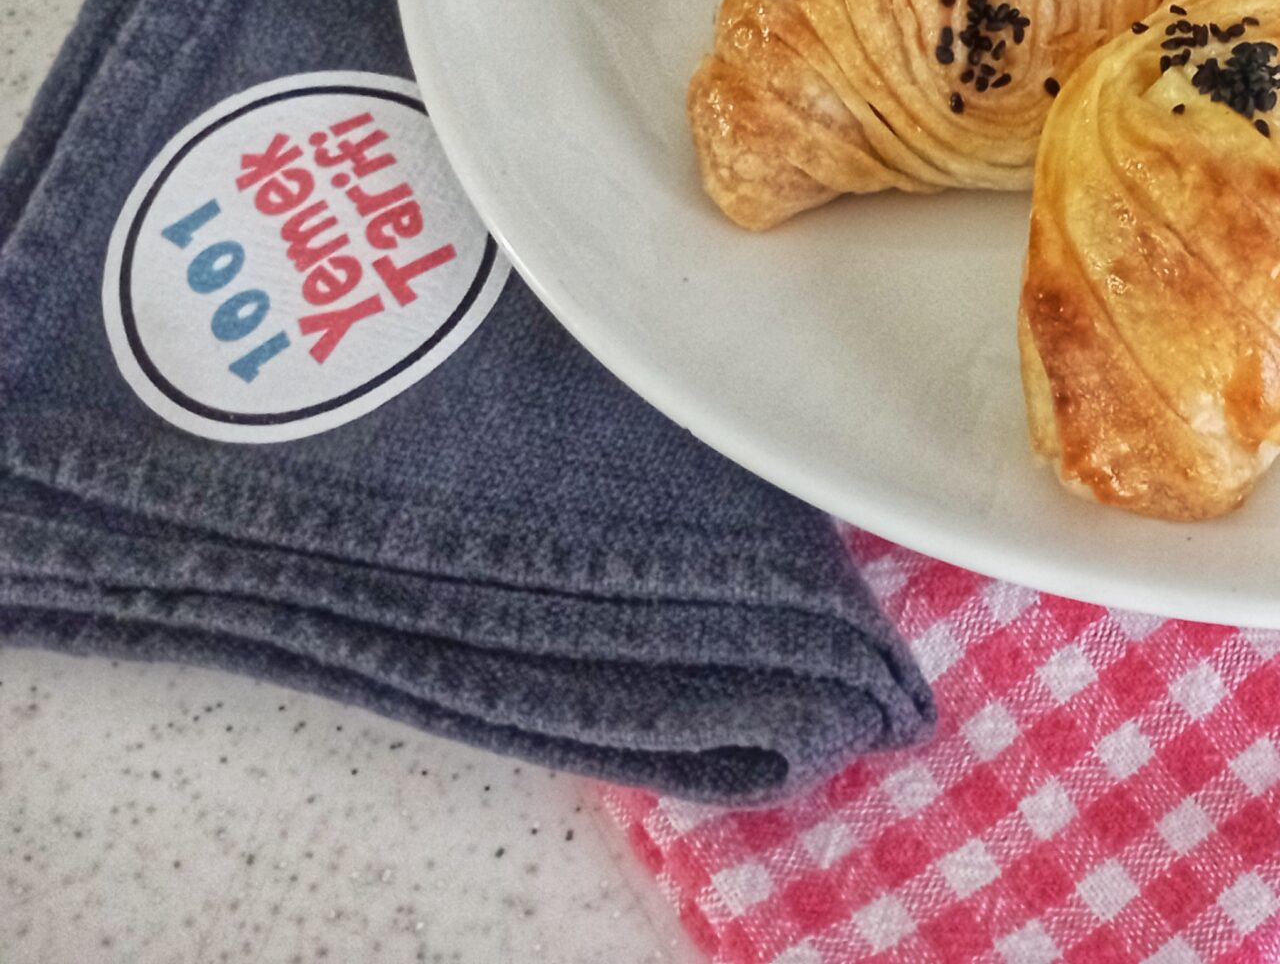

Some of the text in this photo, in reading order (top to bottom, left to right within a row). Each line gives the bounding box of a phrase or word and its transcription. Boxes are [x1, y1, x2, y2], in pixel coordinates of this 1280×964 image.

[161, 199, 290, 384] 1001
[235, 133, 385, 364] Yemek
[308, 112, 457, 307] Tarifi
